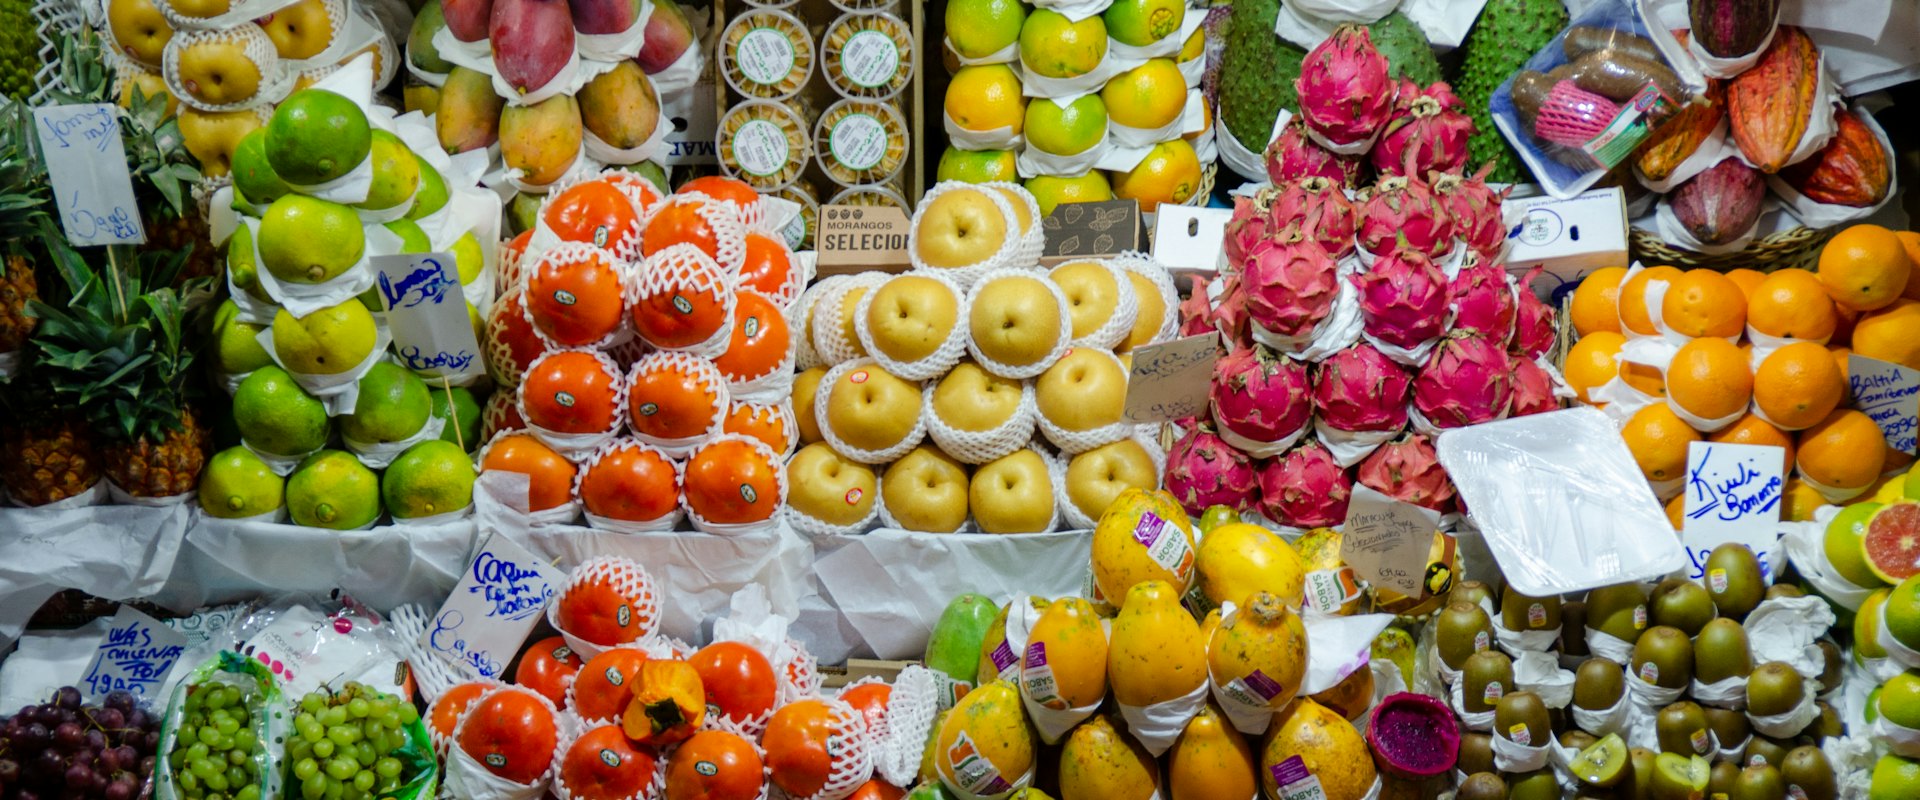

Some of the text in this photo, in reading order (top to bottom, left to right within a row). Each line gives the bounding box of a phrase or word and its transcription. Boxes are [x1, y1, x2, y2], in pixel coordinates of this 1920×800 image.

[827, 222, 893, 230] MORANGOS
[1156, 528, 1181, 561] SABOR
[1312, 574, 1331, 611] SABOR
